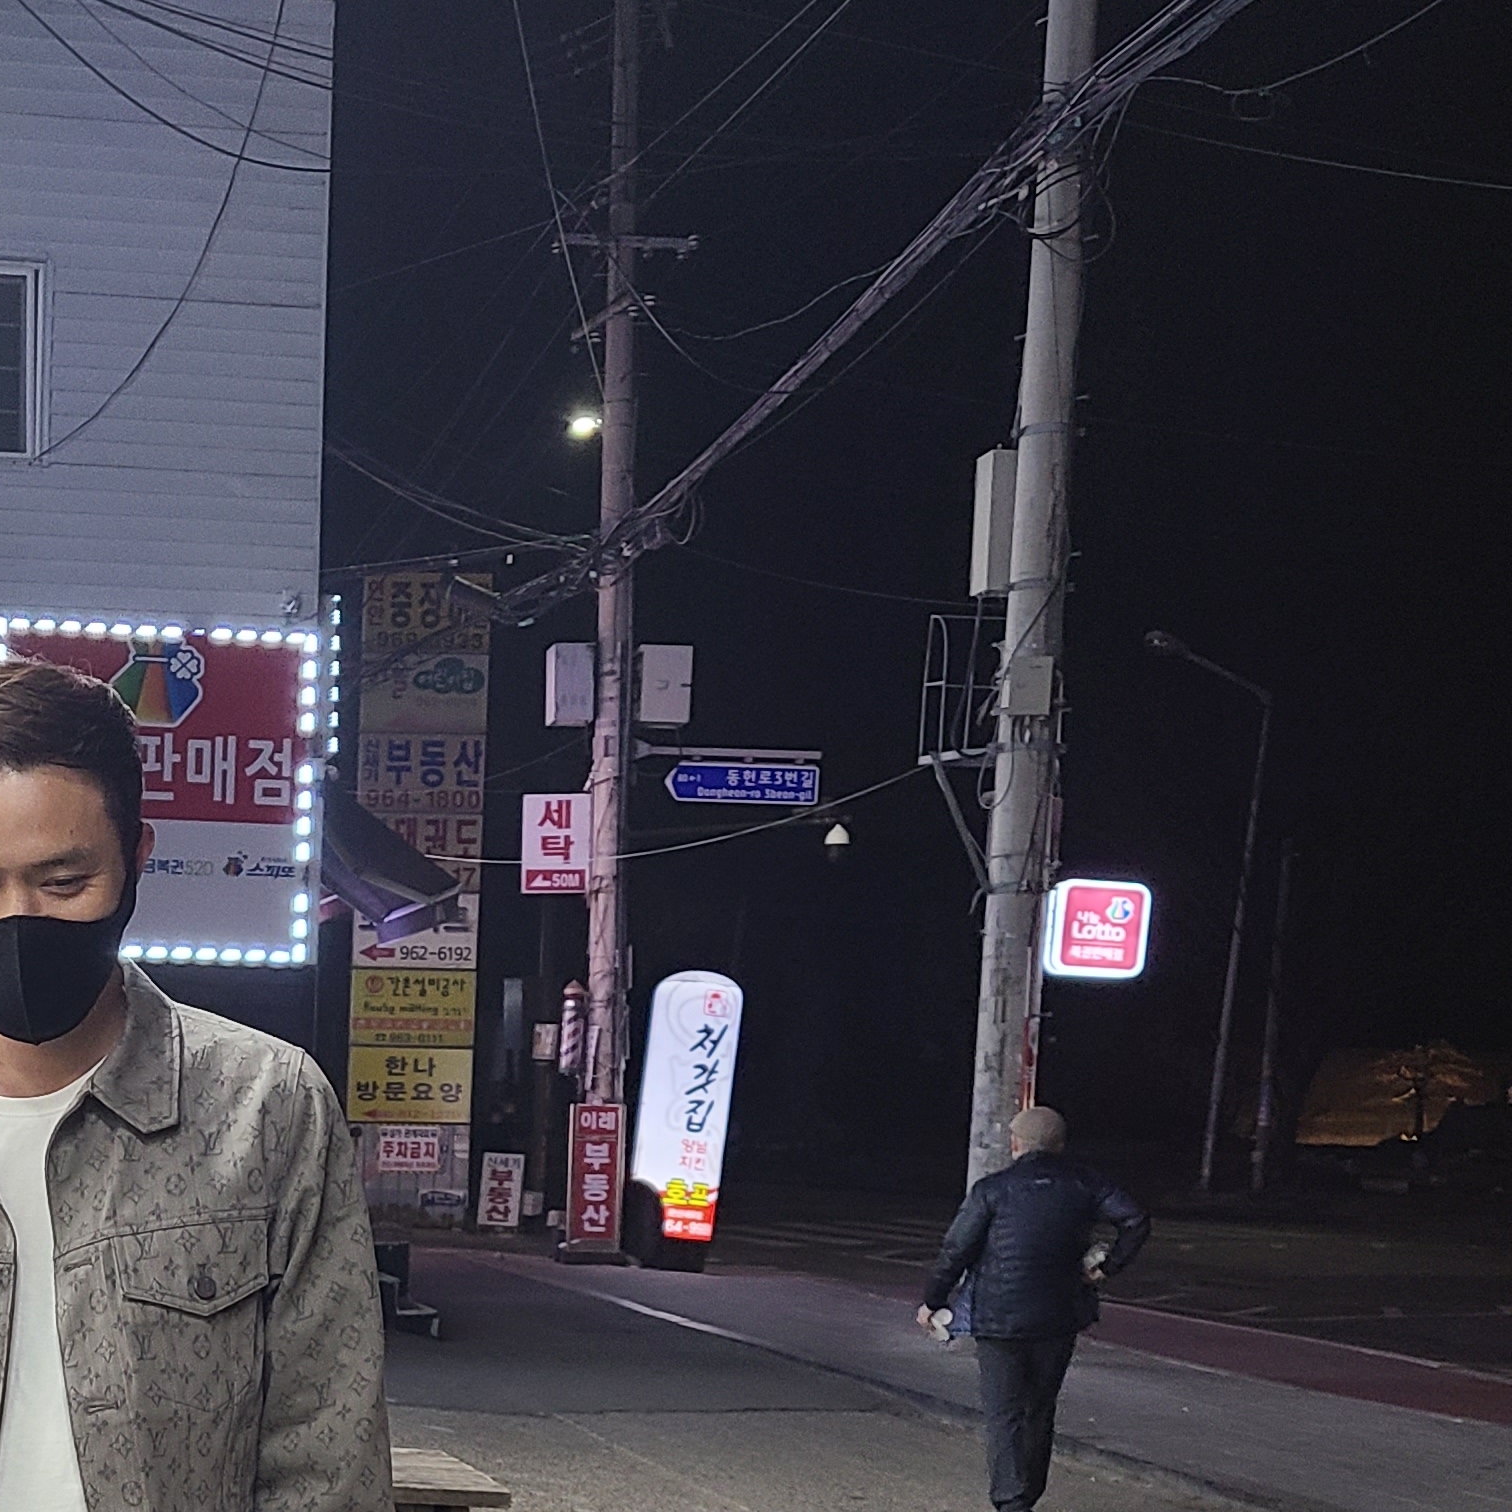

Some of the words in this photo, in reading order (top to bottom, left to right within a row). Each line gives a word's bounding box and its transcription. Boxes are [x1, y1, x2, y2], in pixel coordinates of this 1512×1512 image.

[138, 731, 293, 806] 판매점
[386, 738, 482, 788] 부동산
[537, 799, 575, 865] 세탁
[551, 873, 581, 888] 50M
[1071, 920, 1127, 943] Lotto
[399, 945, 473, 961] 962-6192
[385, 1055, 436, 1077] 한나
[685, 1023, 730, 1134] 처갓집
[356, 1081, 463, 1103] 방문요양
[580, 1111, 616, 1131] 이레
[382, 1141, 436, 1159] 주차금지
[485, 1169, 514, 1222] 부동산
[581, 1142, 612, 1233] 부동산
[660, 1177, 710, 1207] 호프
